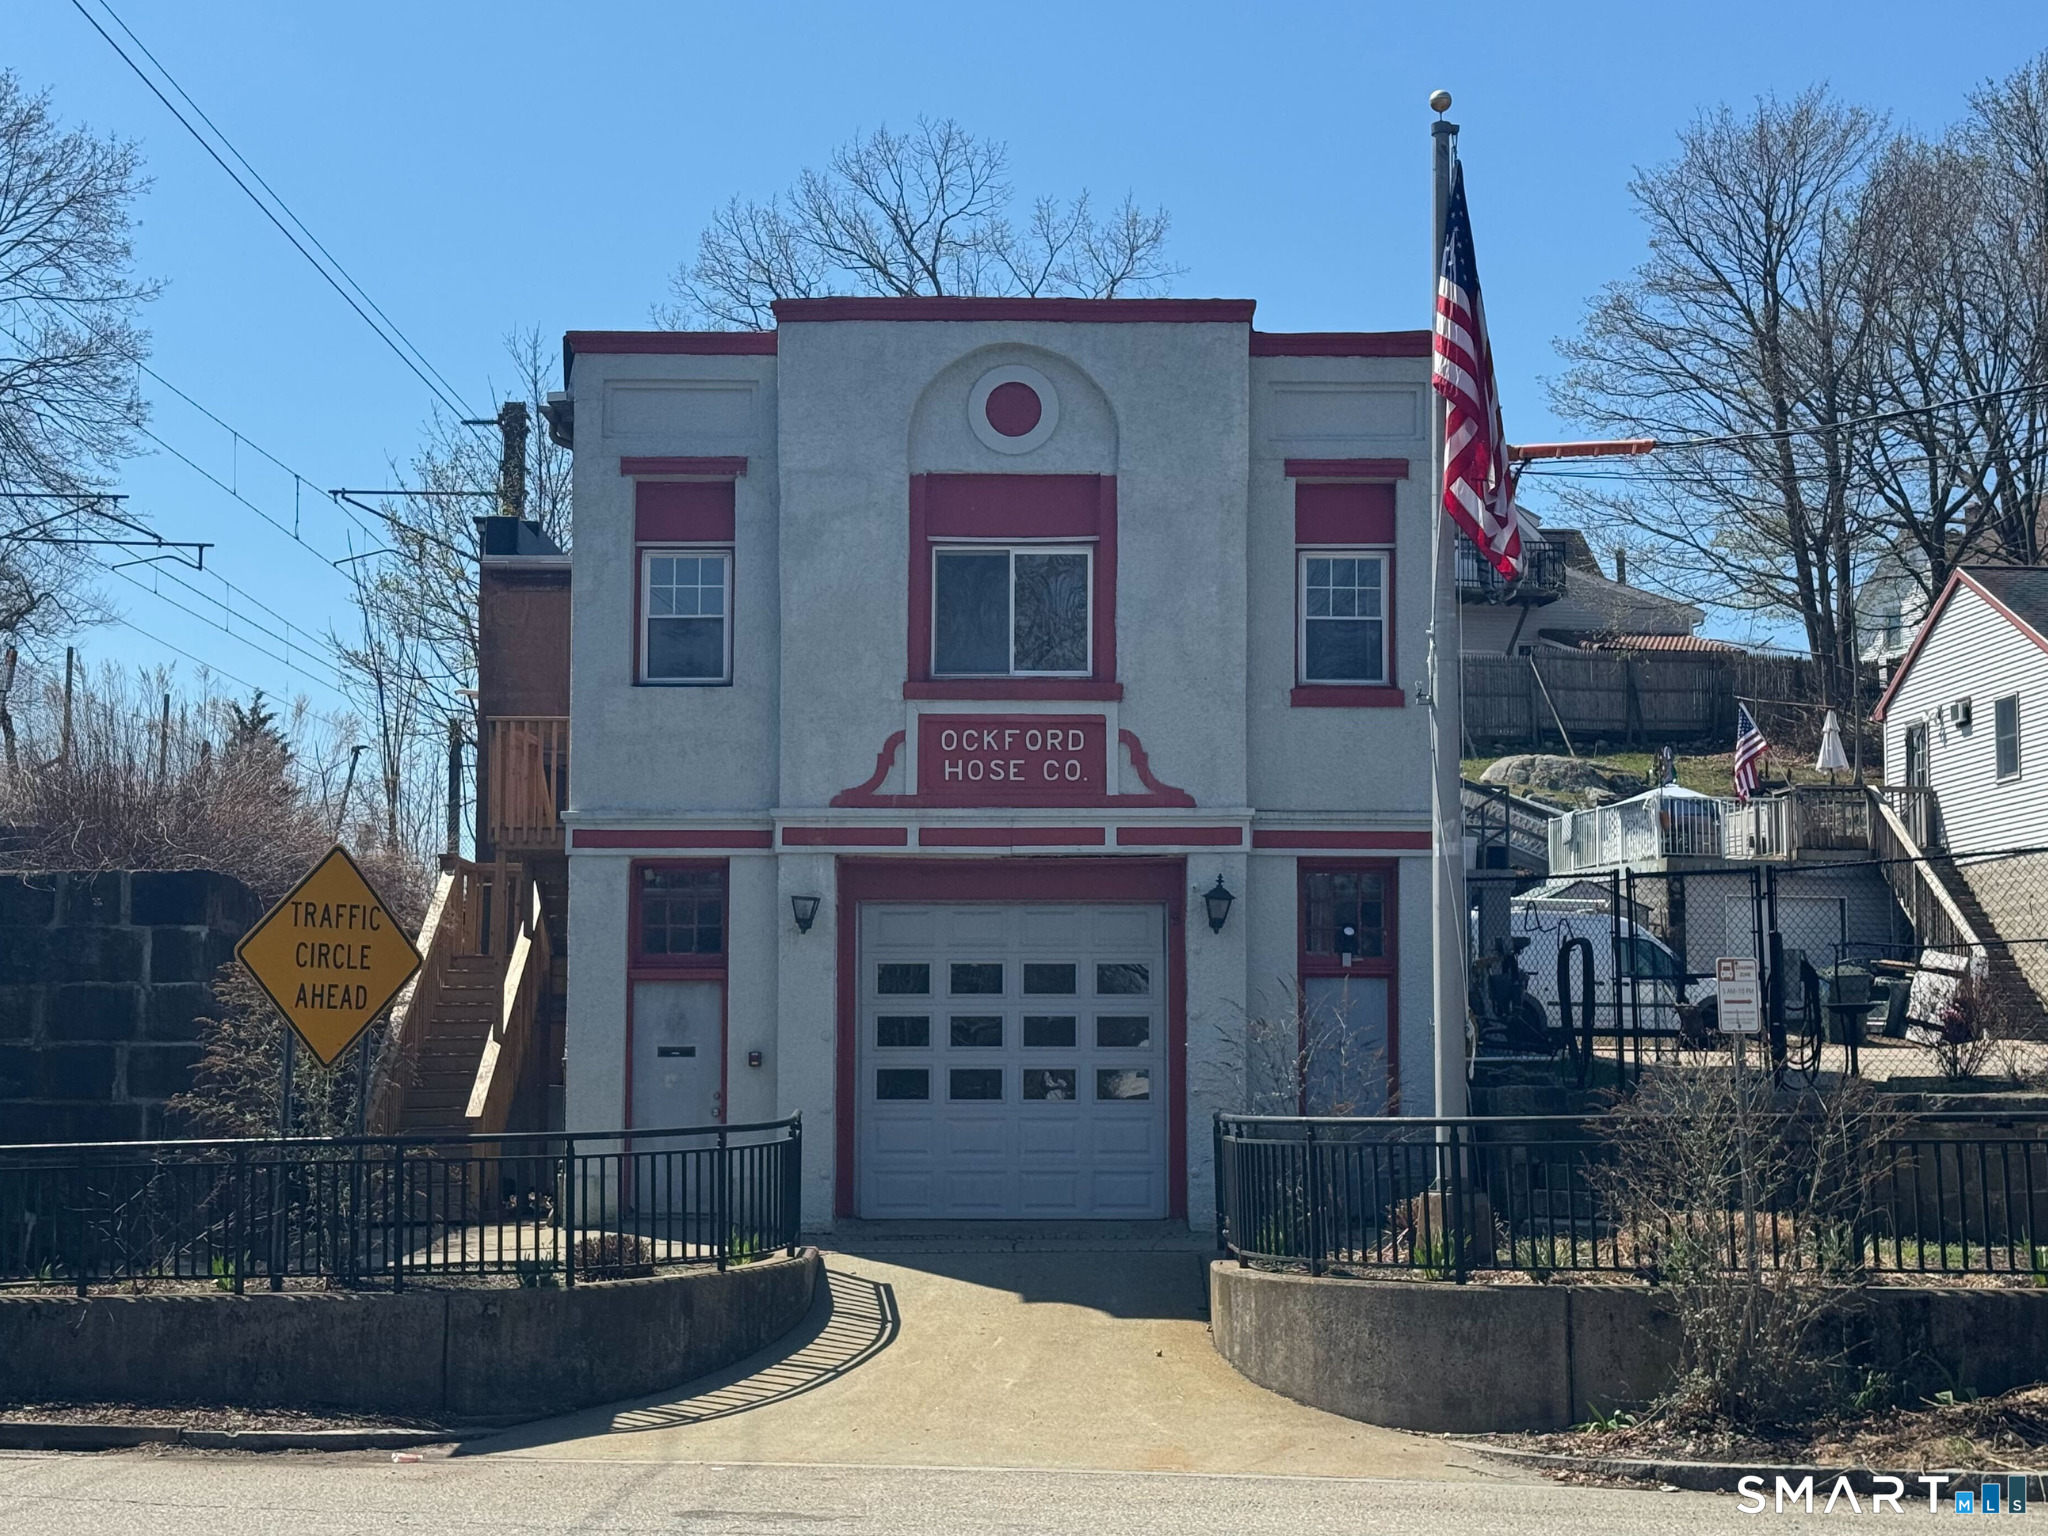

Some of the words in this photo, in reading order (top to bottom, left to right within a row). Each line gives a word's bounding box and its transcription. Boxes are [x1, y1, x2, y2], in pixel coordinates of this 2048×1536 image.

[941, 729, 1085, 751] OCKFORD
[944, 759, 1026, 781] HOSE
[1043, 759, 1088, 781] CO.
[290, 901, 381, 931] TRAFFIC
[295, 942, 371, 970] CIRCLE
[295, 983, 367, 1010] AHEAD
